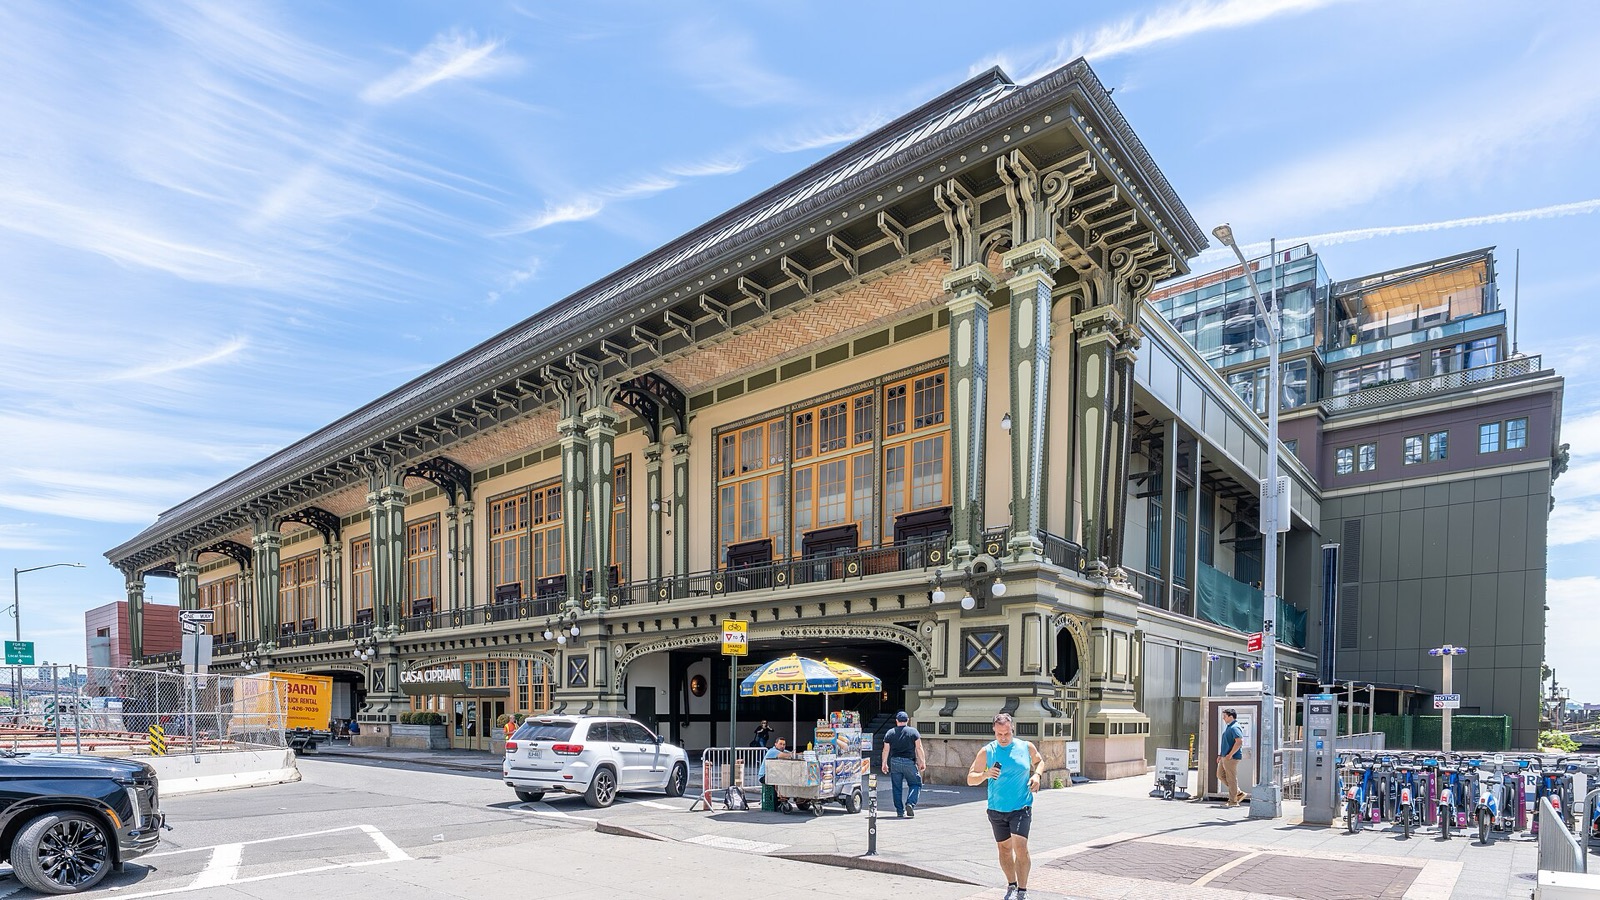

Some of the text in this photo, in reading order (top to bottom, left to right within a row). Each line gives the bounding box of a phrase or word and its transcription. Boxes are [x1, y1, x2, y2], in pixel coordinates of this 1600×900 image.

[400, 668, 461, 683] CASA CIPRIANI
[285, 683, 317, 696] BARN
[758, 682, 804, 693] SABRETT
[849, 681, 873, 689] RETT
[299, 697, 317, 706] RENTAL
